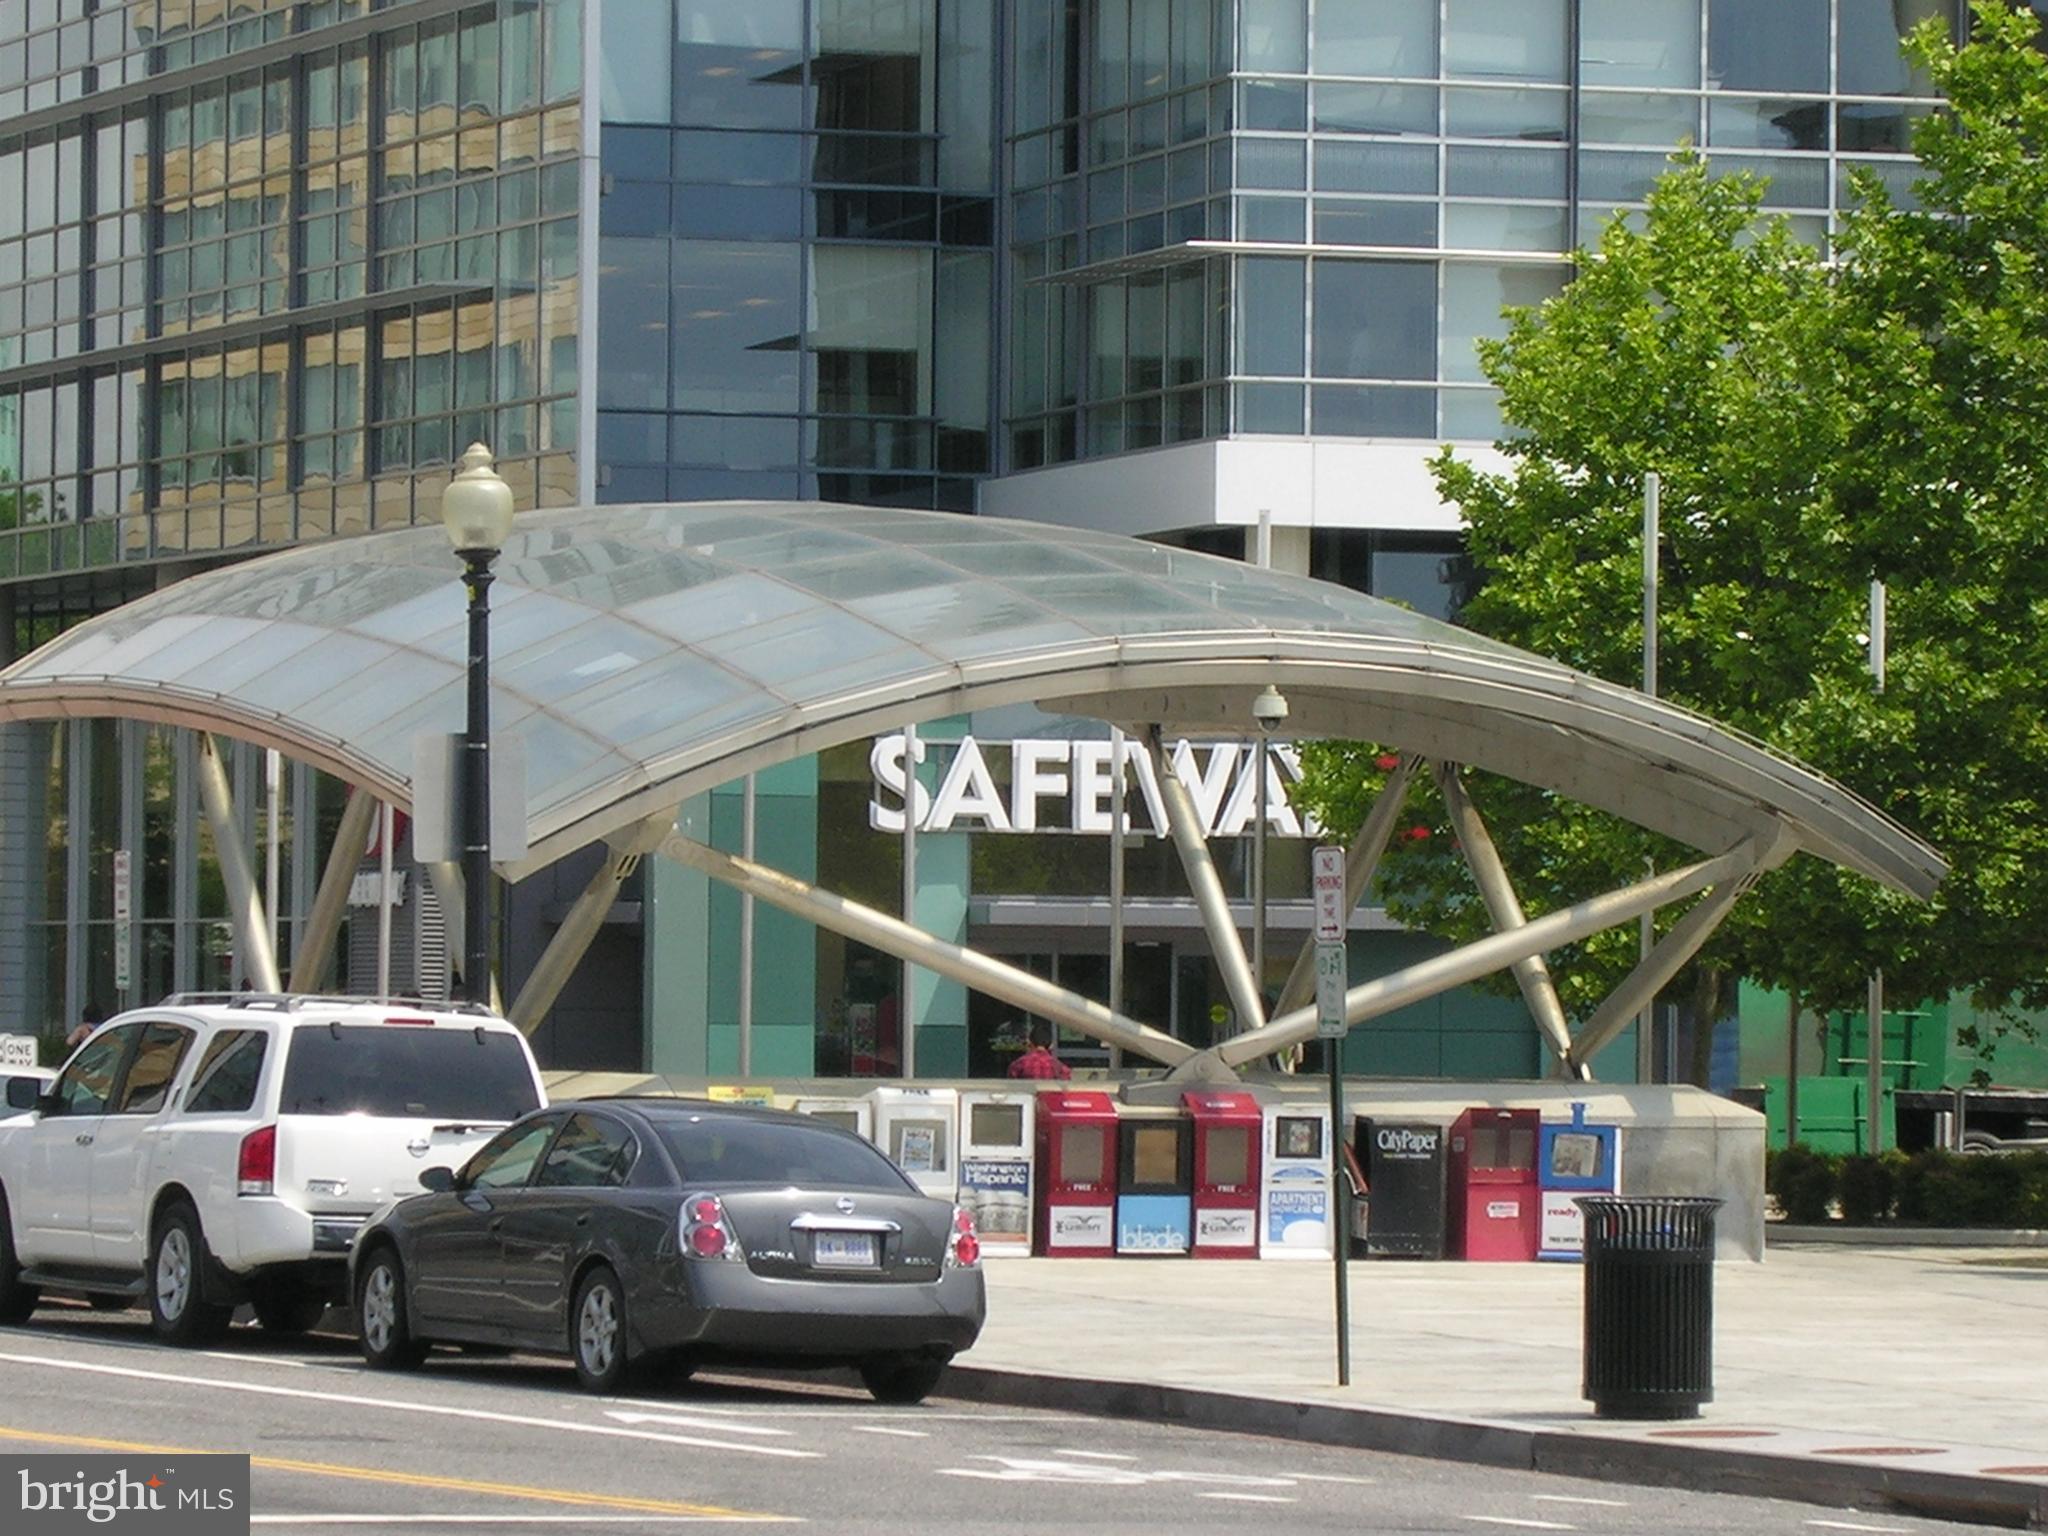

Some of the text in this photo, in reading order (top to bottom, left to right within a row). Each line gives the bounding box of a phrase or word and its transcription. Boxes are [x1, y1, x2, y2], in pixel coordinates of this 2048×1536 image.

[7, 1044, 31, 1056] ONE
[1270, 1192, 1325, 1205] APARTMENT
[1548, 1208, 1578, 1218] ready
[1122, 1224, 1185, 1247] blade
